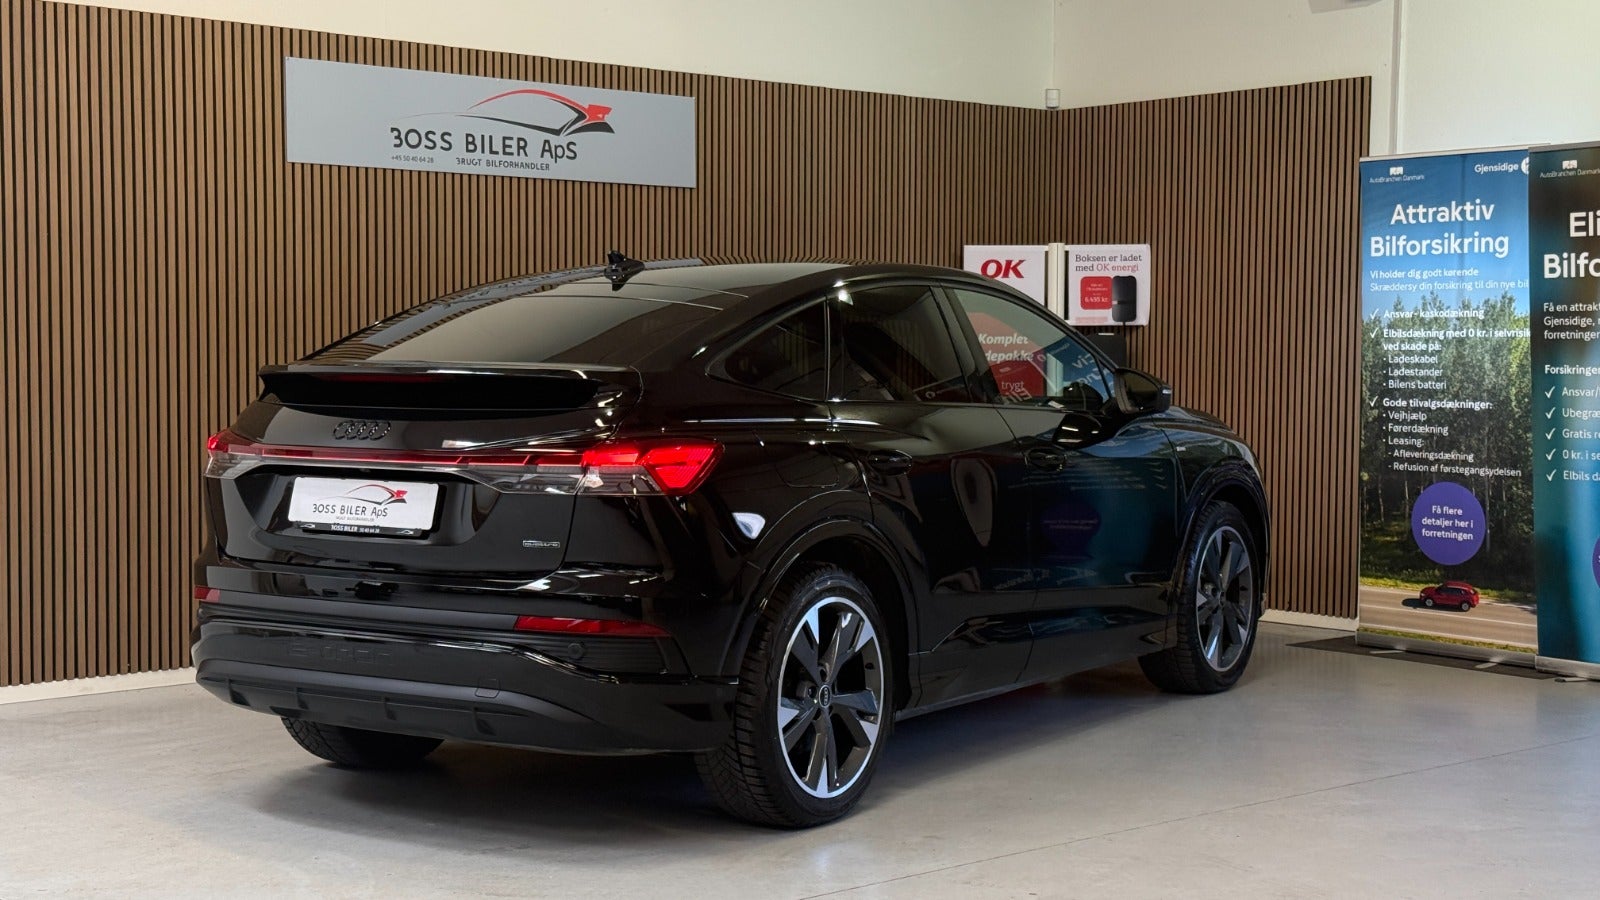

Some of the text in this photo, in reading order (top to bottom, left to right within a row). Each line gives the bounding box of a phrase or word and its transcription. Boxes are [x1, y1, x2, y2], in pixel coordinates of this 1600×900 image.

[465, 133, 529, 157] BILER
[540, 139, 578, 163] ApS
[486, 160, 550, 171] BILFORHANDLER
[1474, 162, 1519, 174] Gjensidige
[1390, 199, 1495, 225] Attraktiv
[1370, 232, 1509, 259] Bilforsikring
[1075, 254, 1106, 263] Boksen
[1119, 253, 1142, 262] ladet
[980, 259, 1026, 279] OK
[1075, 264, 1139, 273] med OK energi
[1543, 252, 1600, 279] Bilfo
[1370, 268, 1479, 279] Vi holder dig godt kørende
[1370, 282, 1417, 292] Skræddersy
[1419, 281, 1432, 290] din
[1434, 280, 1473, 291] forsikring
[1474, 280, 1484, 289] til
[1485, 280, 1499, 289] din
[1500, 281, 1516, 291] nye
[1543, 302, 1555, 312] Få
[1556, 304, 1568, 312] en
[1419, 309, 1485, 319] kaskodækning
[1543, 316, 1595, 328] Gjensidige,
[978, 333, 1028, 347] Komplet
[1383, 329, 1445, 340] Elbilsdækning
[1446, 329, 1466, 338] med
[1468, 329, 1475, 338] 0
[1383, 342, 1442, 352] ved skade på:
[985, 350, 1034, 364] depakke
[1388, 354, 1438, 364] Ladeskabel
[1388, 367, 1443, 376] Ladestander
[1001, 380, 1024, 393] trygt
[1388, 380, 1447, 389] Bilens batteri
[1562, 386, 1600, 397] Ansvar/
[1382, 398, 1407, 408] Gode
[1388, 411, 1427, 422] Vejhjælp
[1388, 424, 1449, 435] Førerdækning
[1562, 428, 1592, 439] Gratis
[1393, 450, 1474, 462] Afleveringsdækning
[1562, 449, 1569, 459] 0
[1571, 449, 1583, 460] kr.
[1393, 462, 1522, 478] Refusion af førstegangsydelsen
[1563, 470, 1590, 481] Elbils
[340, 504, 366, 516] BILER
[370, 507, 388, 518] ApS
[1432, 505, 1463, 515] Få flere
[1421, 517, 1453, 529] detaljer
[1454, 519, 1469, 528] her
[1421, 529, 1474, 541] forretningen
